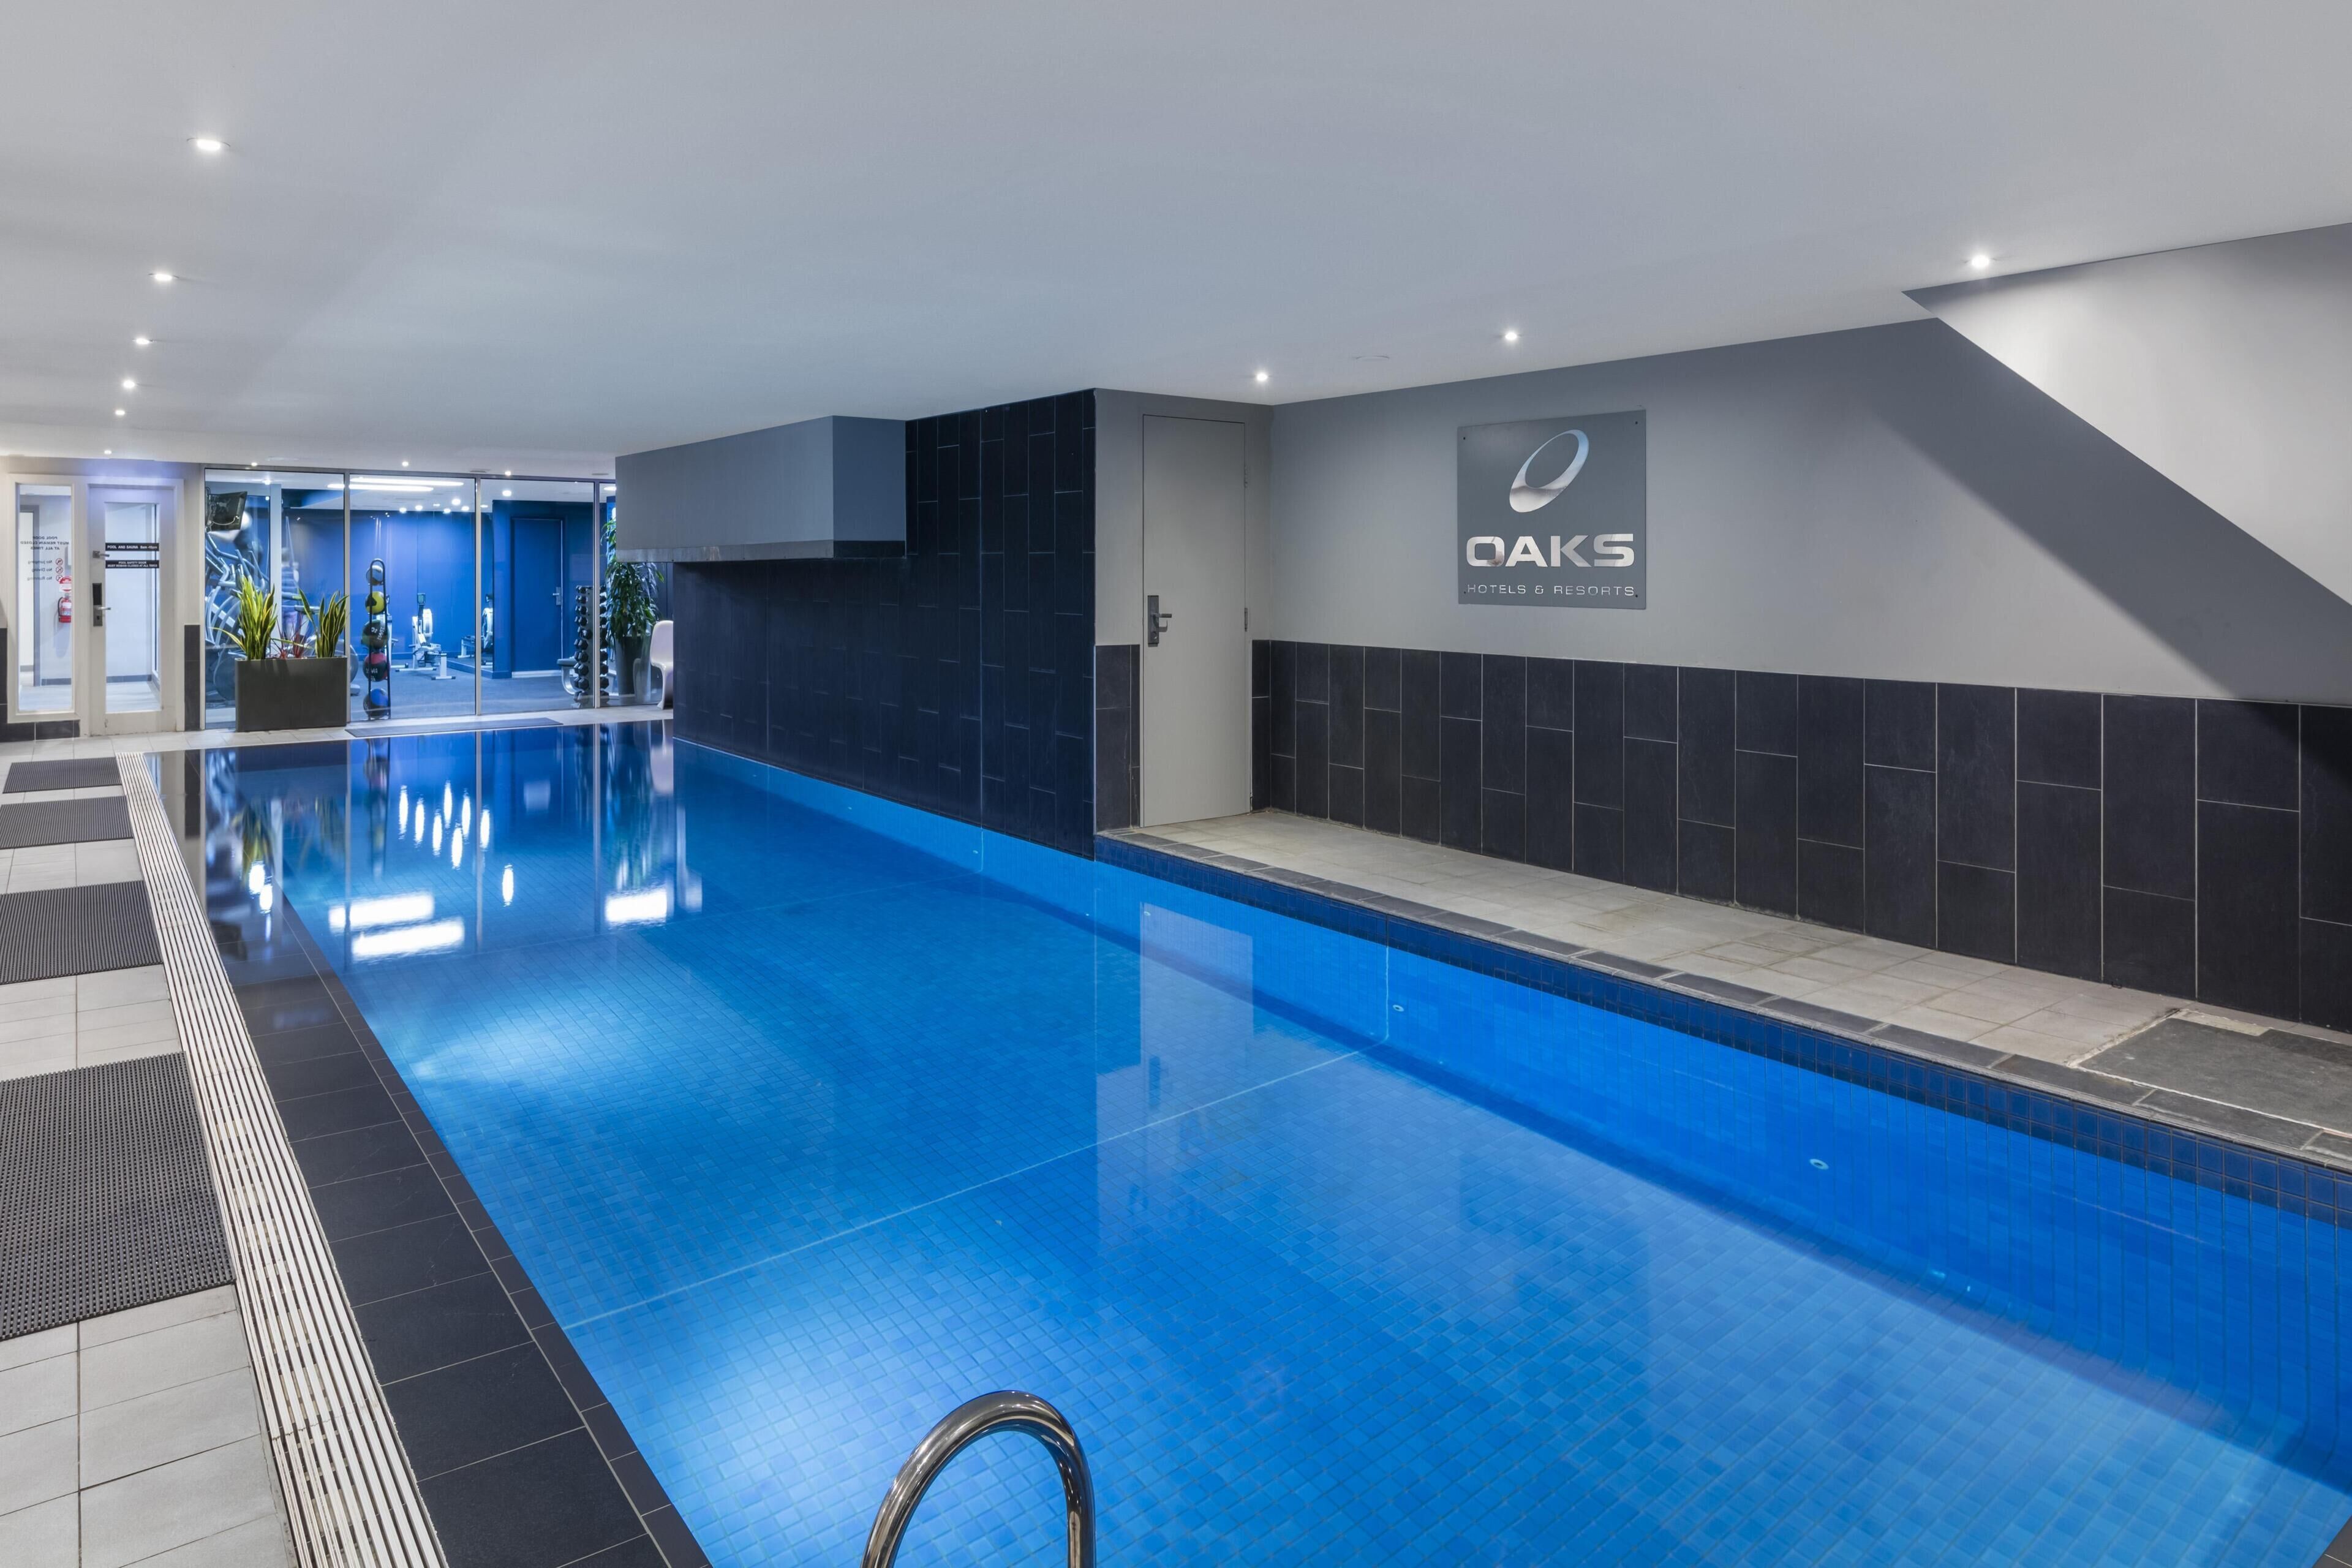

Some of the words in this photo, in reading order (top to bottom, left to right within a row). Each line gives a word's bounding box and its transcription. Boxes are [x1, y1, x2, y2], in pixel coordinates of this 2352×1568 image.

[1466, 533, 1635, 568] OAKS
[1468, 584, 1526, 594] HOTELS
[1535, 585, 1544, 594] &
[1554, 586, 1635, 596] RESORTS
